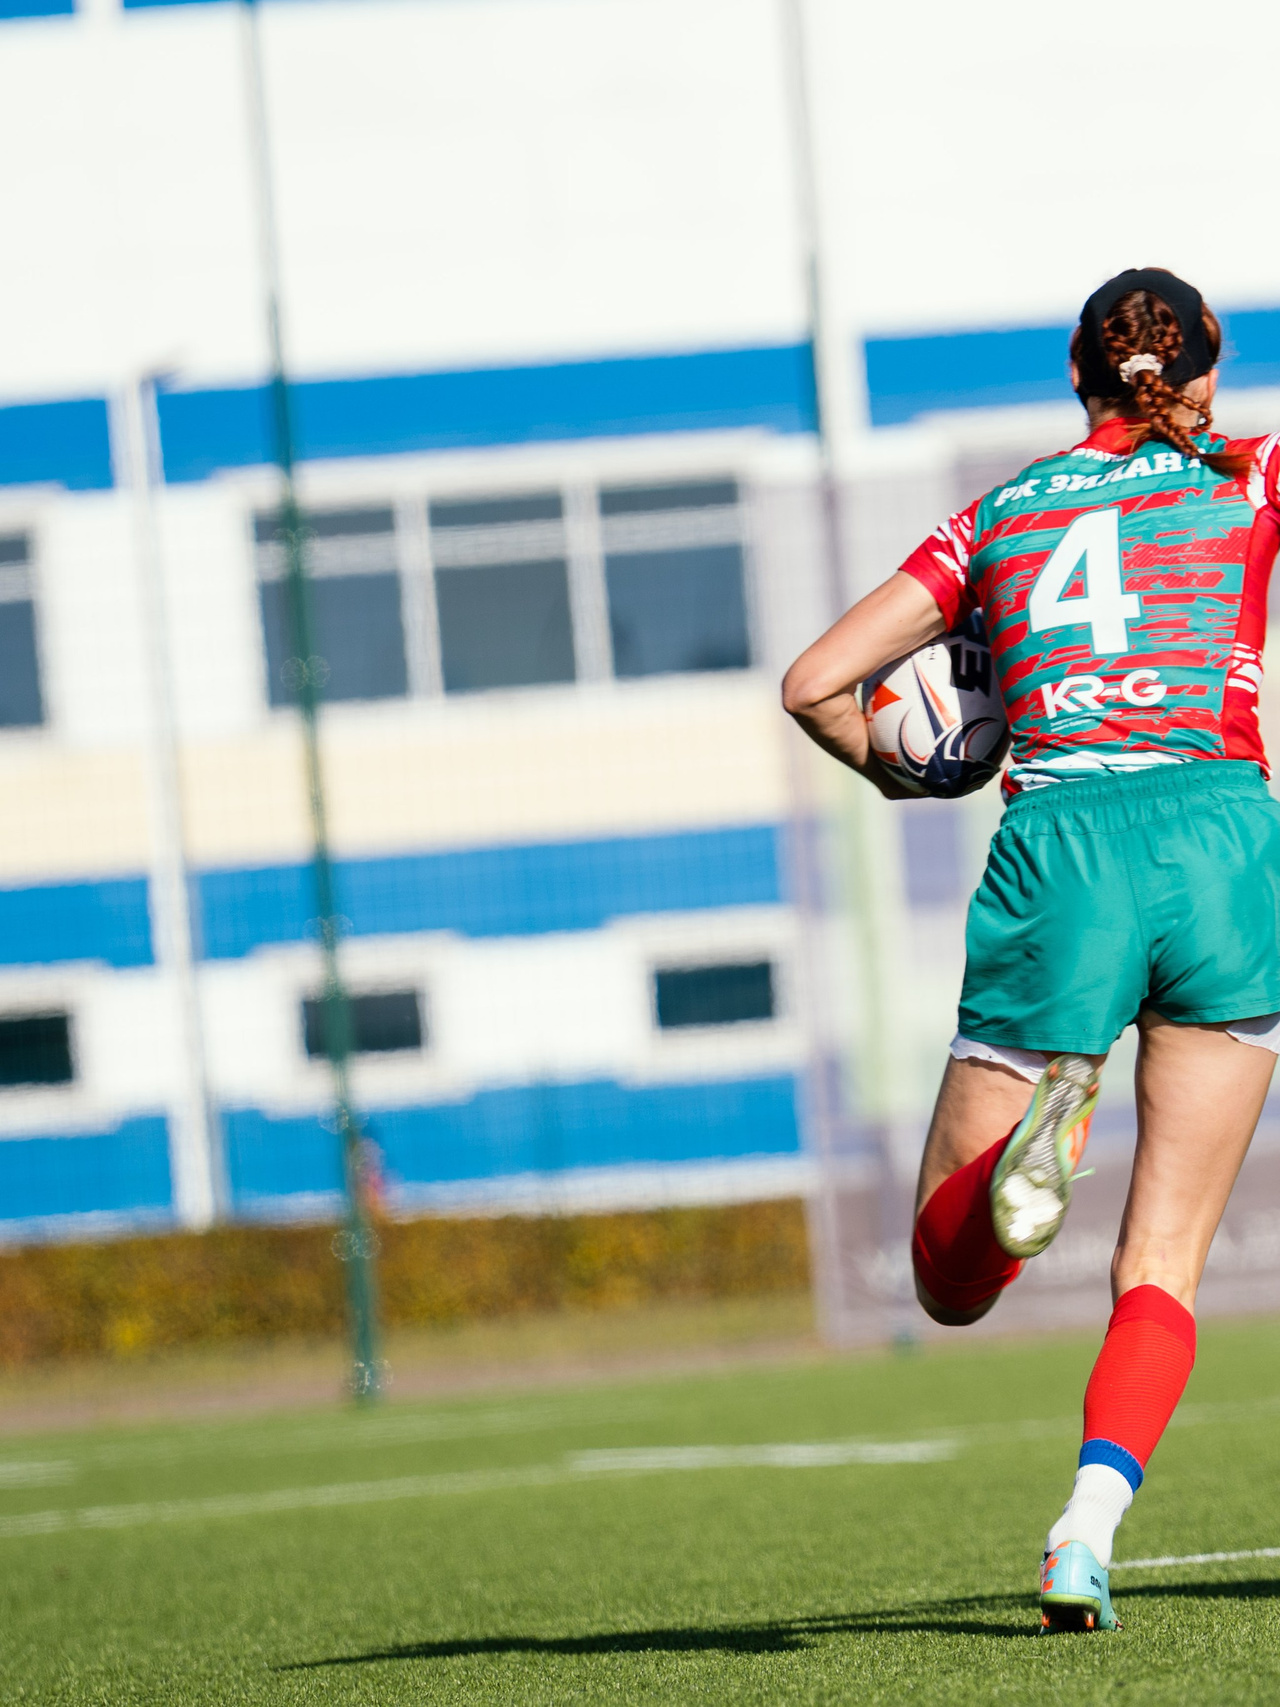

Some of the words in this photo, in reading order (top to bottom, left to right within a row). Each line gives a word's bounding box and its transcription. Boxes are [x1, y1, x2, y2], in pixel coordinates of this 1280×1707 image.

[994, 479, 1041, 507] РК
[1029, 507, 1141, 655] 4
[1041, 669, 1168, 719] KR-G
